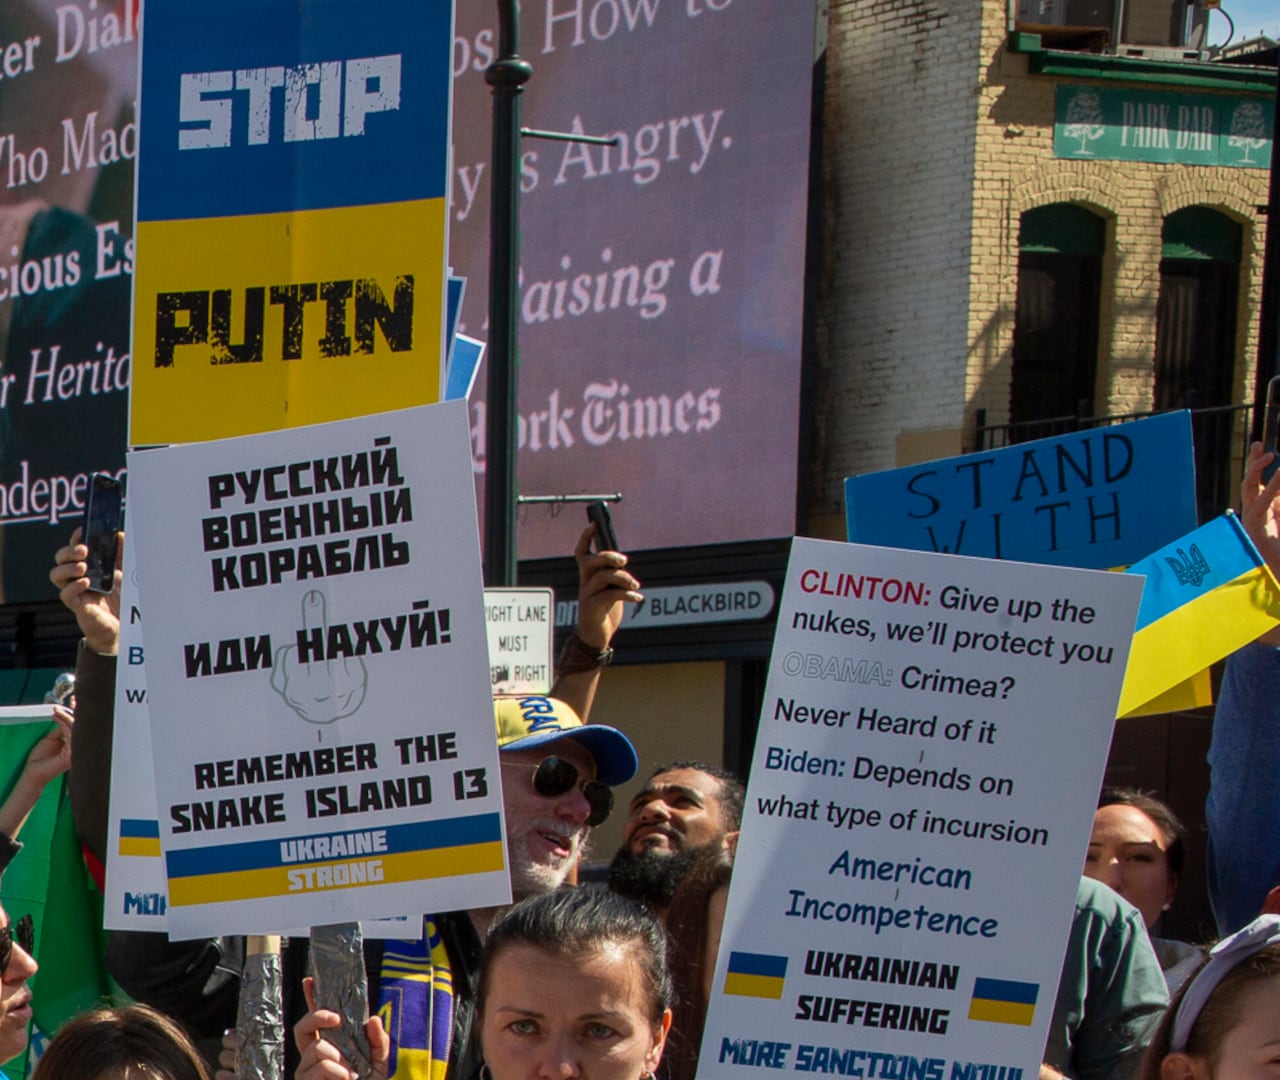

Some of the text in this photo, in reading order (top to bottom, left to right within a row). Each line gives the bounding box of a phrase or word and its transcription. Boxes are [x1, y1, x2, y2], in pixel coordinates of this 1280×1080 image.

[541, 0, 663, 54] How
[178, 54, 402, 150] STOP
[1120, 101, 1213, 151] PARK BAR
[553, 108, 733, 186] Angry.
[690, 249, 724, 297] a
[154, 274, 414, 368] PUTIN
[582, 378, 721, 446] Times
[208, 436, 405, 509] РУССКИЙ
[907, 433, 1134, 518] STAND
[925, 492, 1122, 560] WITH
[211, 533, 410, 592] КОРАБЛЬ
[517, 606, 547, 621] LANE
[650, 591, 761, 616] BLACKBIRD
[799, 568, 1096, 624] CLINTON: Give up the
[184, 635, 273, 678] ИДИ
[296, 600, 452, 664] НАХУЙ!
[498, 635, 528, 652] MUST
[791, 608, 1114, 664] nukes, we’ll protect you
[514, 665, 546, 681] RIGHT
[782, 650, 1016, 701] OBAMA: Crimea?
[775, 698, 997, 744] Never Heard of it
[194, 732, 458, 790] REMEMBER THE
[764, 747, 1014, 796] Biden: Depends on
[170, 768, 488, 834] SNAKE ISLAND 13
[756, 795, 1050, 847] what type of incursion
[279, 829, 388, 863] UKRAINE
[829, 849, 972, 890] American
[287, 859, 384, 891] STRONG
[784, 889, 999, 938] Incompetence
[804, 950, 960, 990] UKRAINIAN
[795, 994, 951, 1035] SUFFERING
[718, 1037, 792, 1069] MORE
